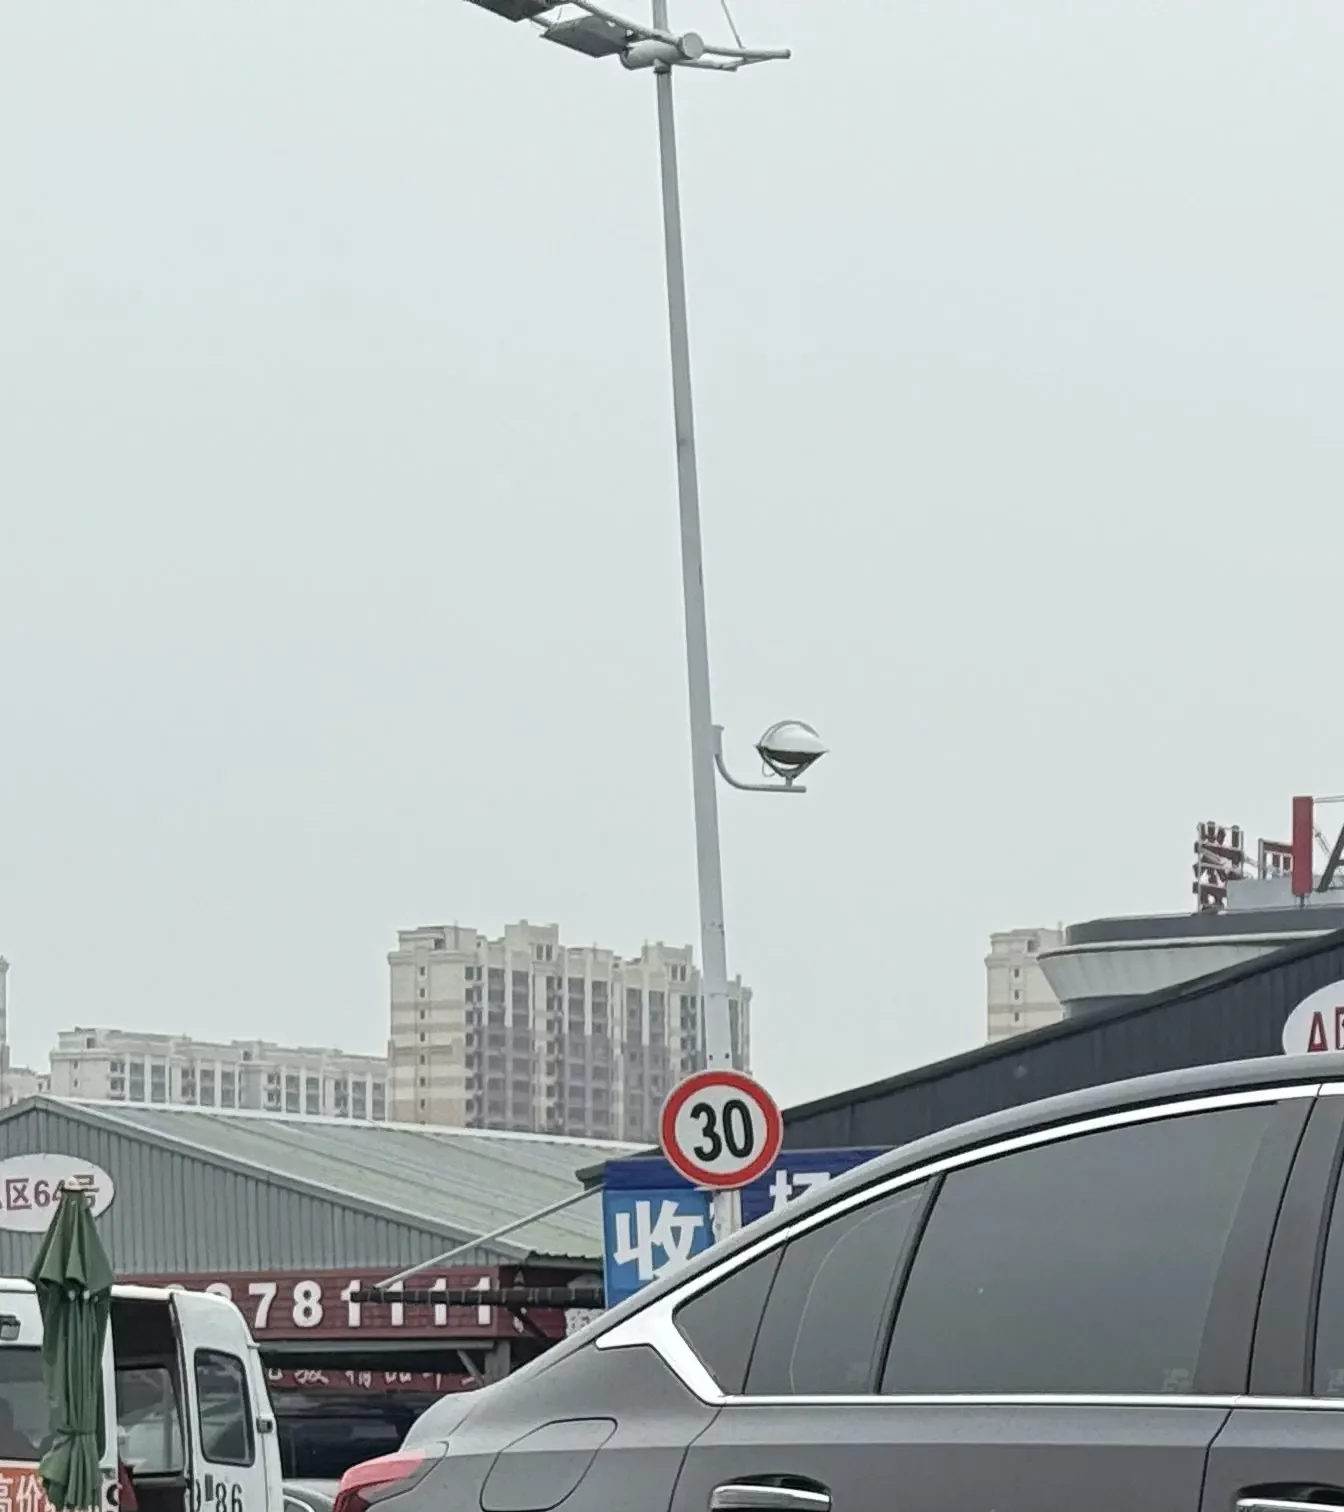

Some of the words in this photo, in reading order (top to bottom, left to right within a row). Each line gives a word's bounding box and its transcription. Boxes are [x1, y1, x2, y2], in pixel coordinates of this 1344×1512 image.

[690, 1099, 754, 1162] 30
[0, 1173, 100, 1211] 区6号
[613, 1199, 717, 1281] 收
[165, 1279, 492, 1329] 781111
